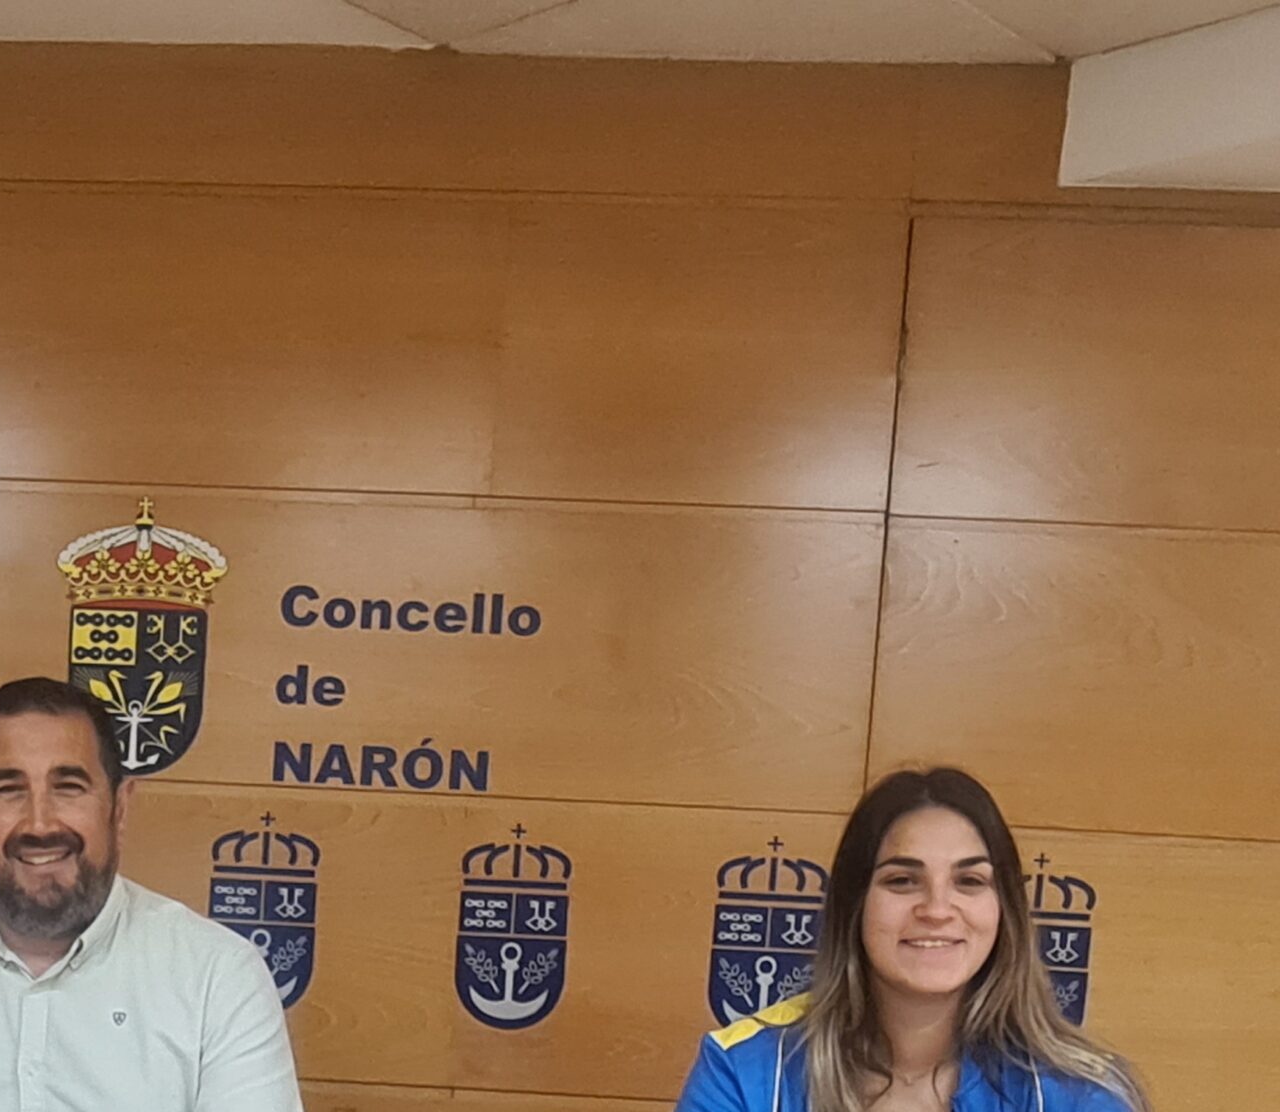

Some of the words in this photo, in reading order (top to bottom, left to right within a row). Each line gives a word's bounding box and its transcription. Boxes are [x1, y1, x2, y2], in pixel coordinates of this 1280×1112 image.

[280, 585, 542, 636] Concello
[275, 665, 346, 706] de
[272, 737, 489, 791] NARÓN
